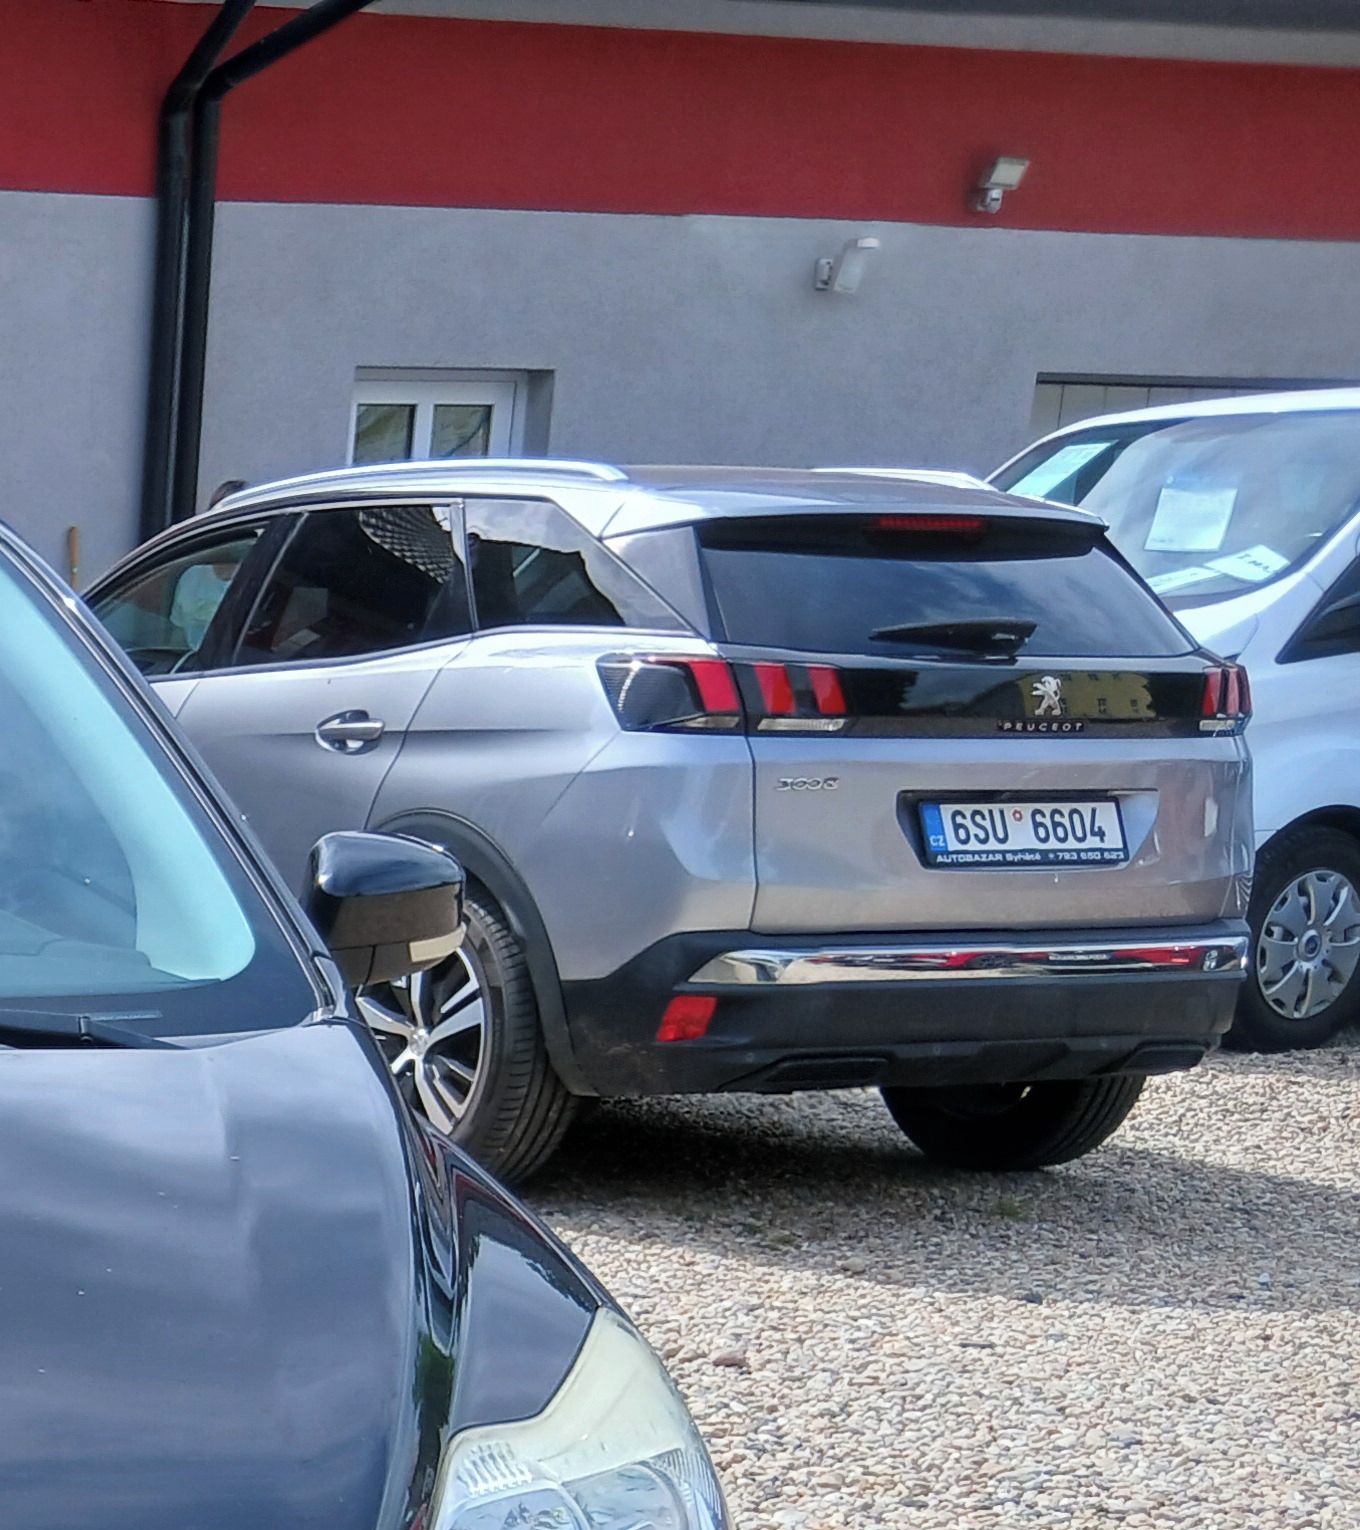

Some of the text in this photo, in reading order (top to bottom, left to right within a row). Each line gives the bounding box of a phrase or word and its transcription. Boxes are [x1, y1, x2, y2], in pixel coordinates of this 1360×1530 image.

[950, 807, 1106, 845] 6SU 6604
[930, 835, 946, 847] CZ
[936, 853, 1003, 863] AUTOBAZAR
